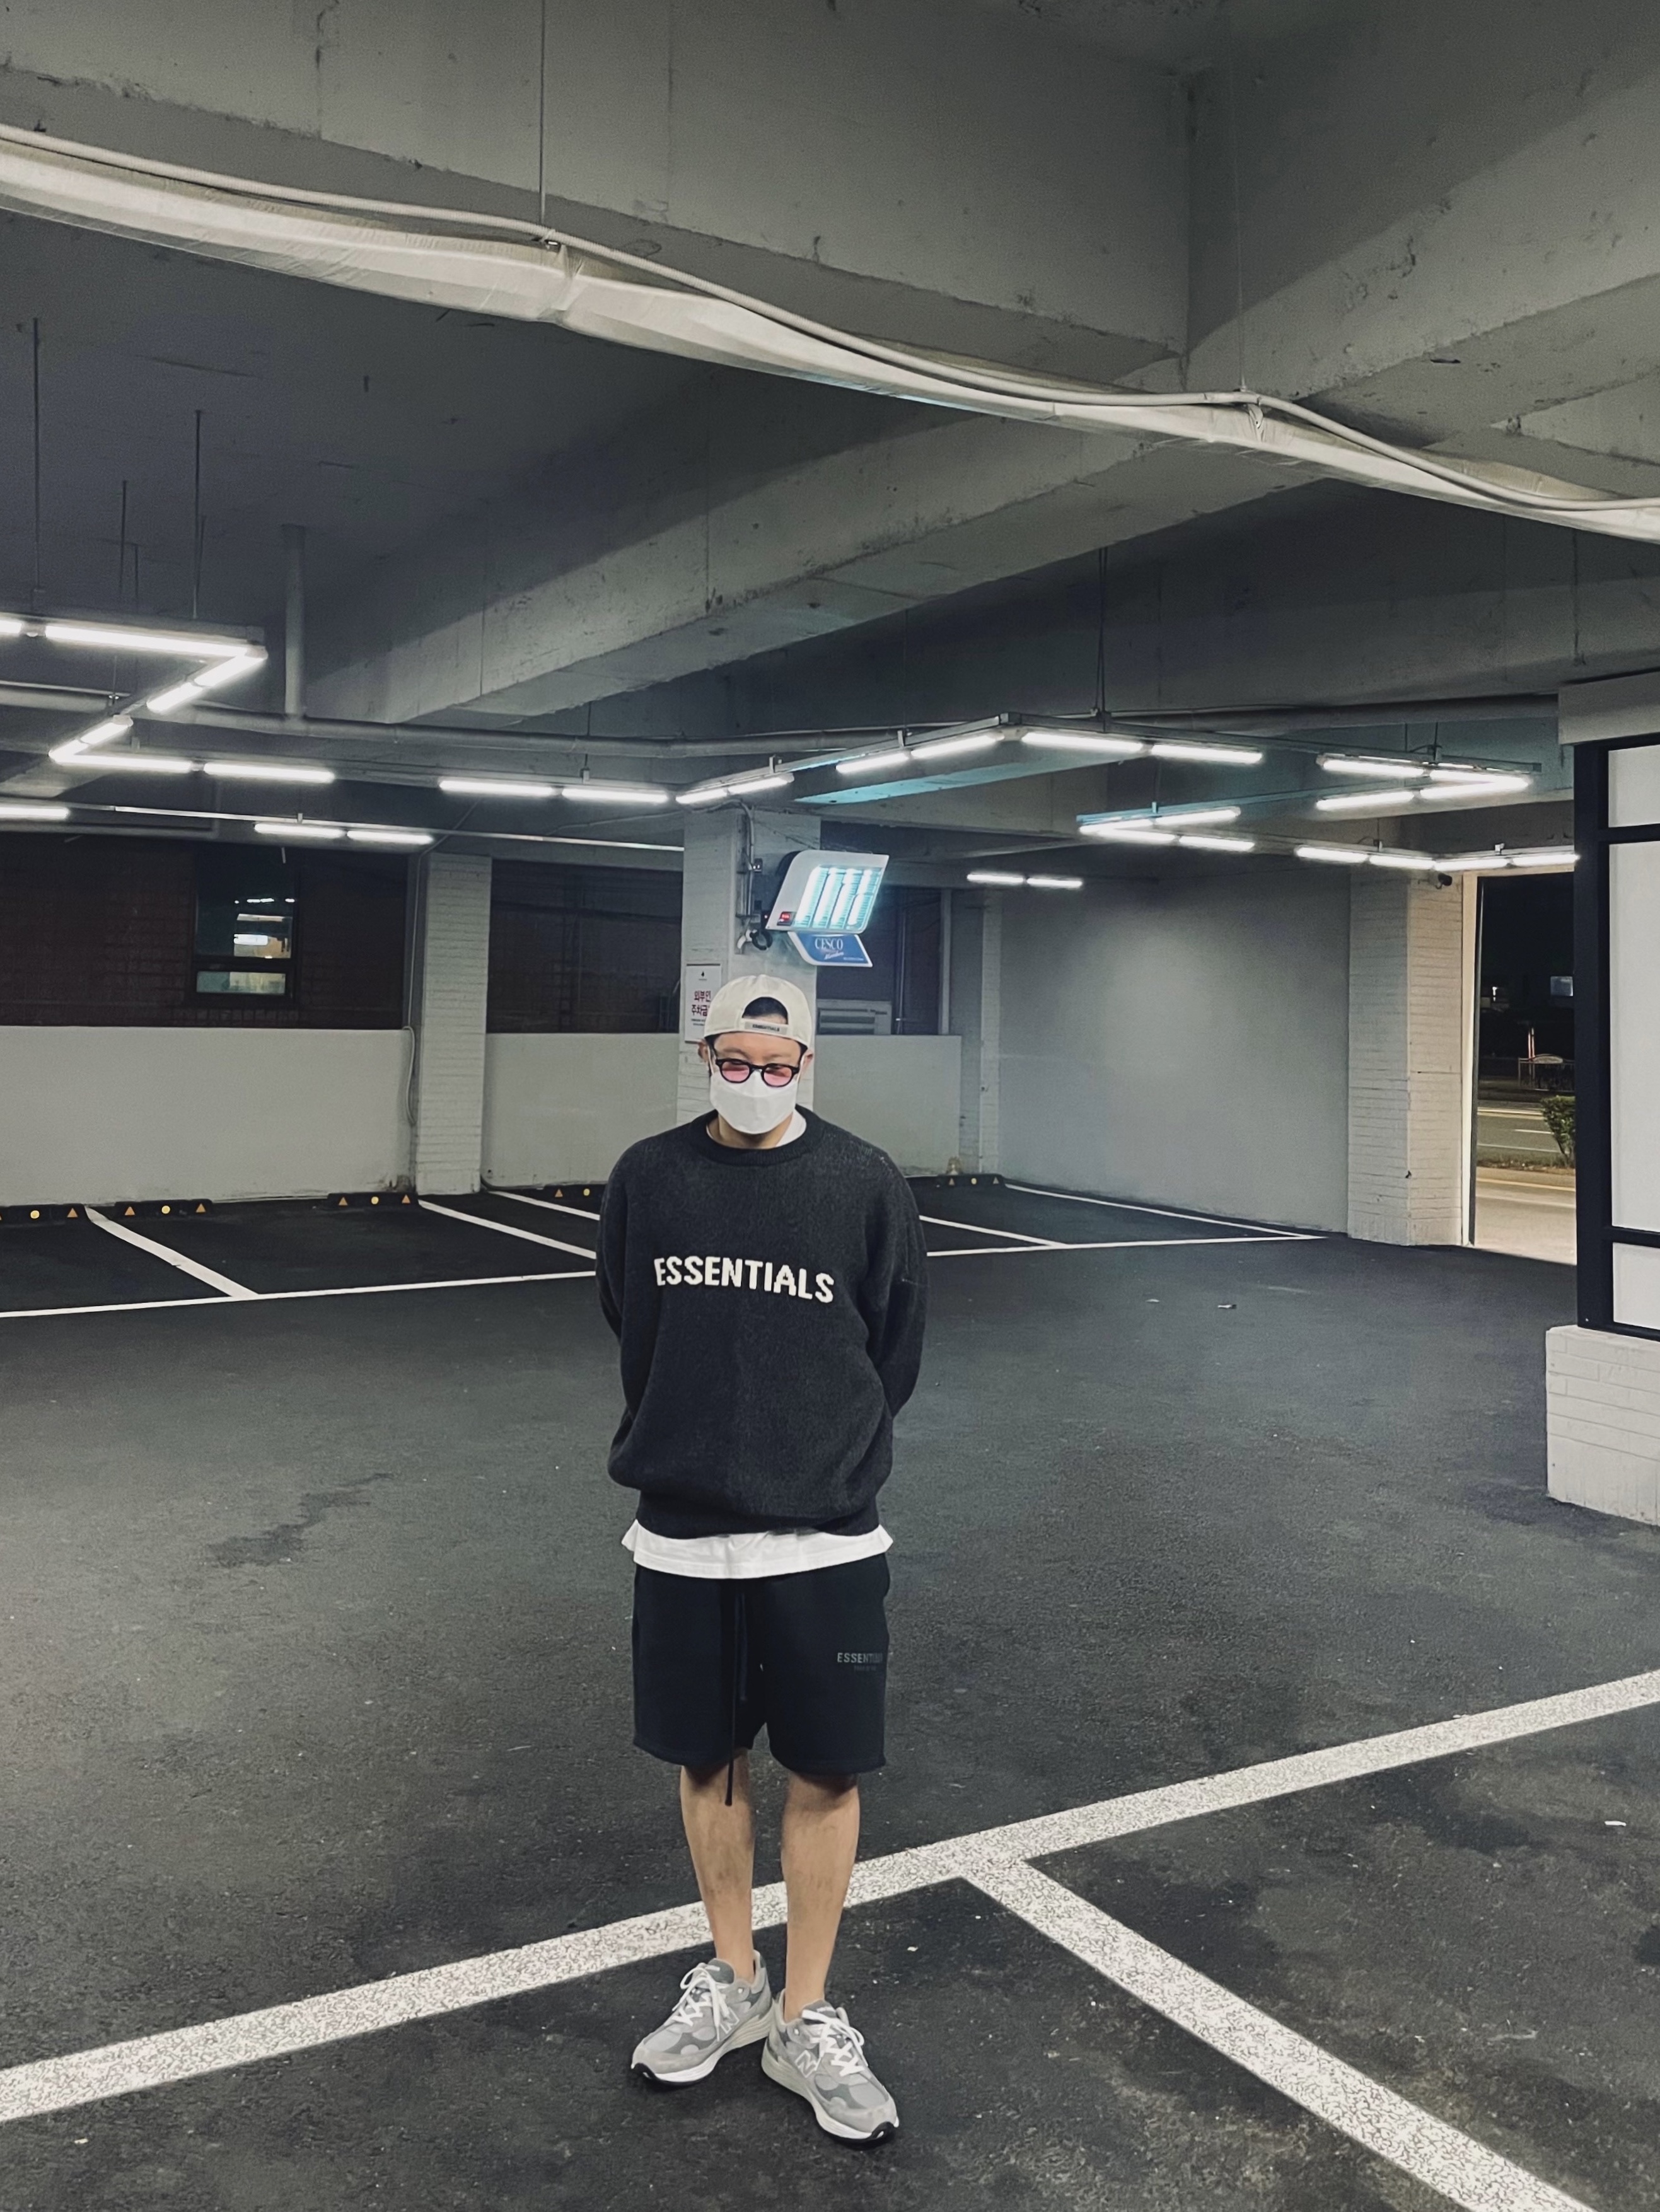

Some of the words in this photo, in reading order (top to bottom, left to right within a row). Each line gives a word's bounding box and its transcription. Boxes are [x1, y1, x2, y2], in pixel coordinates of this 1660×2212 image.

[815, 937, 844, 951] CESCO
[694, 990, 711, 1002] 외부인
[692, 1004, 710, 1016] 주차금
[654, 1256, 834, 1303] ESSENTIALS
[795, 2050, 818, 2078] N
